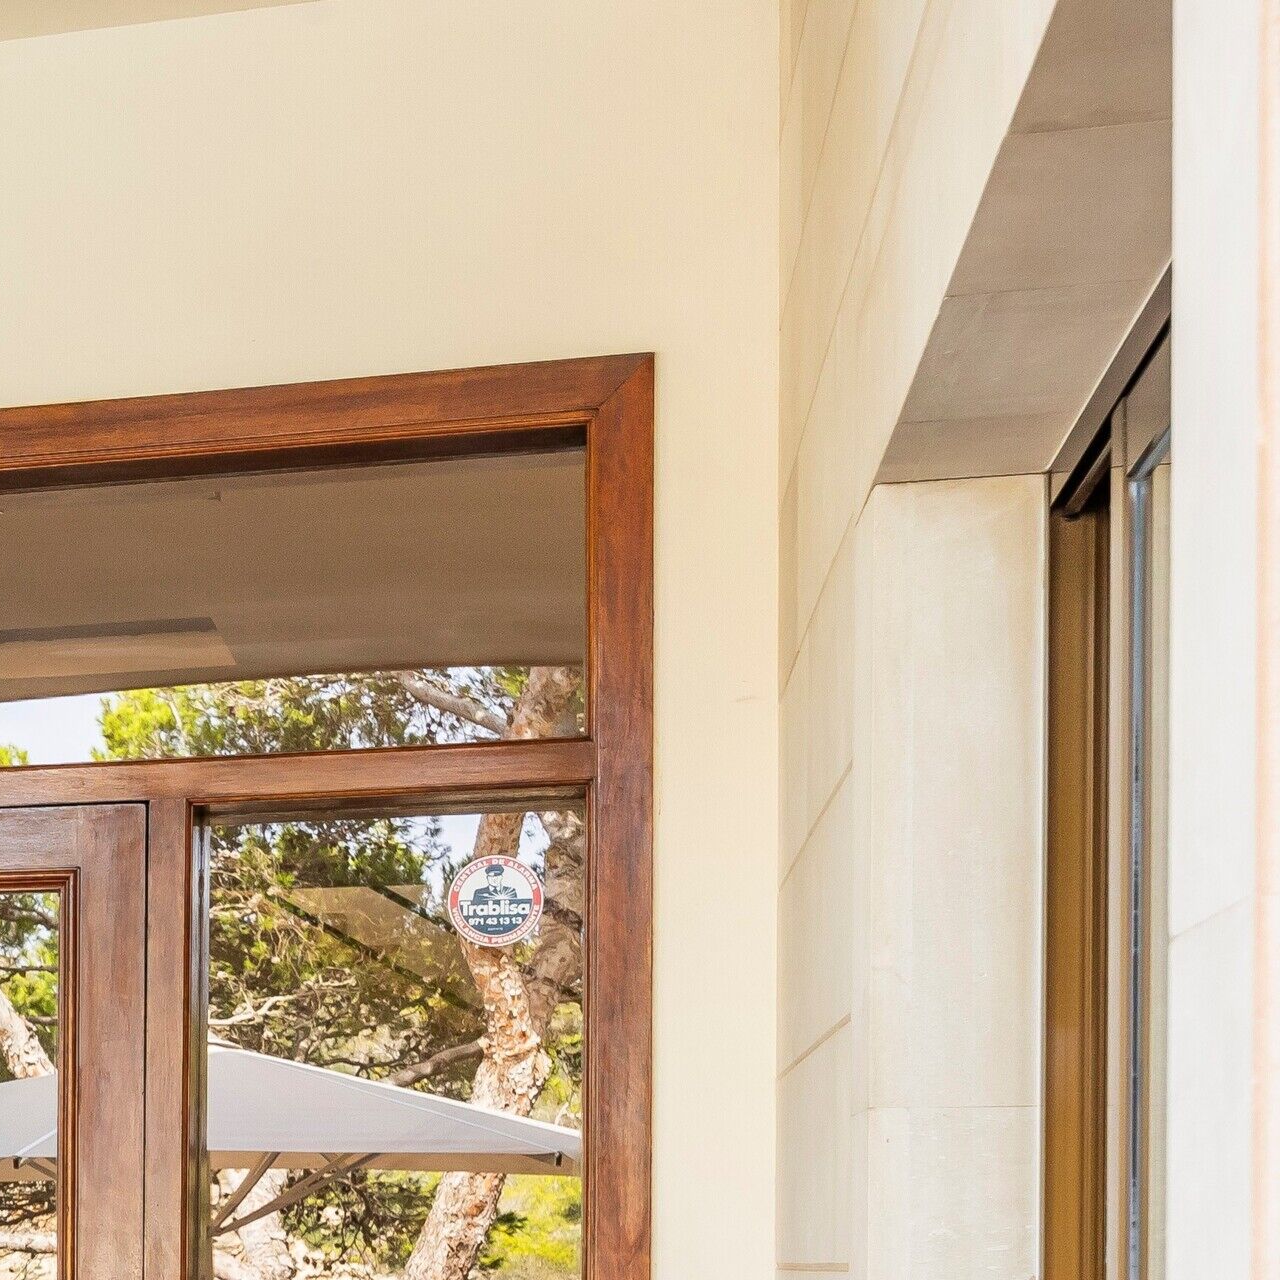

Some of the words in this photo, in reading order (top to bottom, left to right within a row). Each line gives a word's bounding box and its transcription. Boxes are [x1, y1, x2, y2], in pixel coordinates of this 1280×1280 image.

[453, 859, 491, 892] CENTRAL
[508, 860, 538, 890] ALARMA
[460, 900, 530, 916] Trablisa
[451, 906, 489, 943] VIGILANCIA
[491, 905, 540, 943] PERMANENTE
[468, 917, 485, 926] 971
[486, 917, 498, 925] 43
[499, 916, 510, 925] 13
[511, 916, 522, 925] 13
